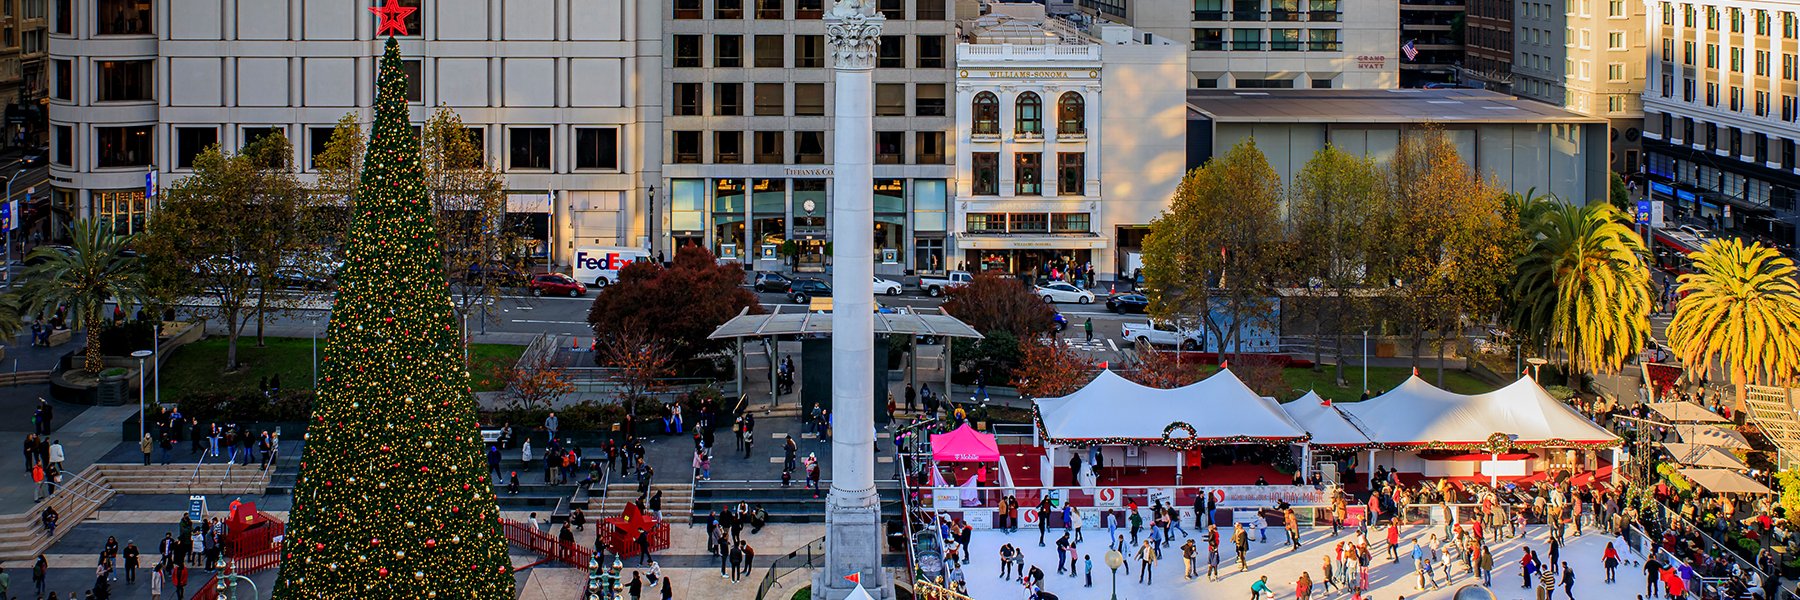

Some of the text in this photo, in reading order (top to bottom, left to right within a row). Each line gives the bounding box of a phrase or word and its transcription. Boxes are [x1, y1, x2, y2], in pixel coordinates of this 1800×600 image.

[577, 251, 633, 271] FedEx
[1269, 492, 1299, 504] HOLIDAY
[1302, 492, 1325, 503] MAGIC
